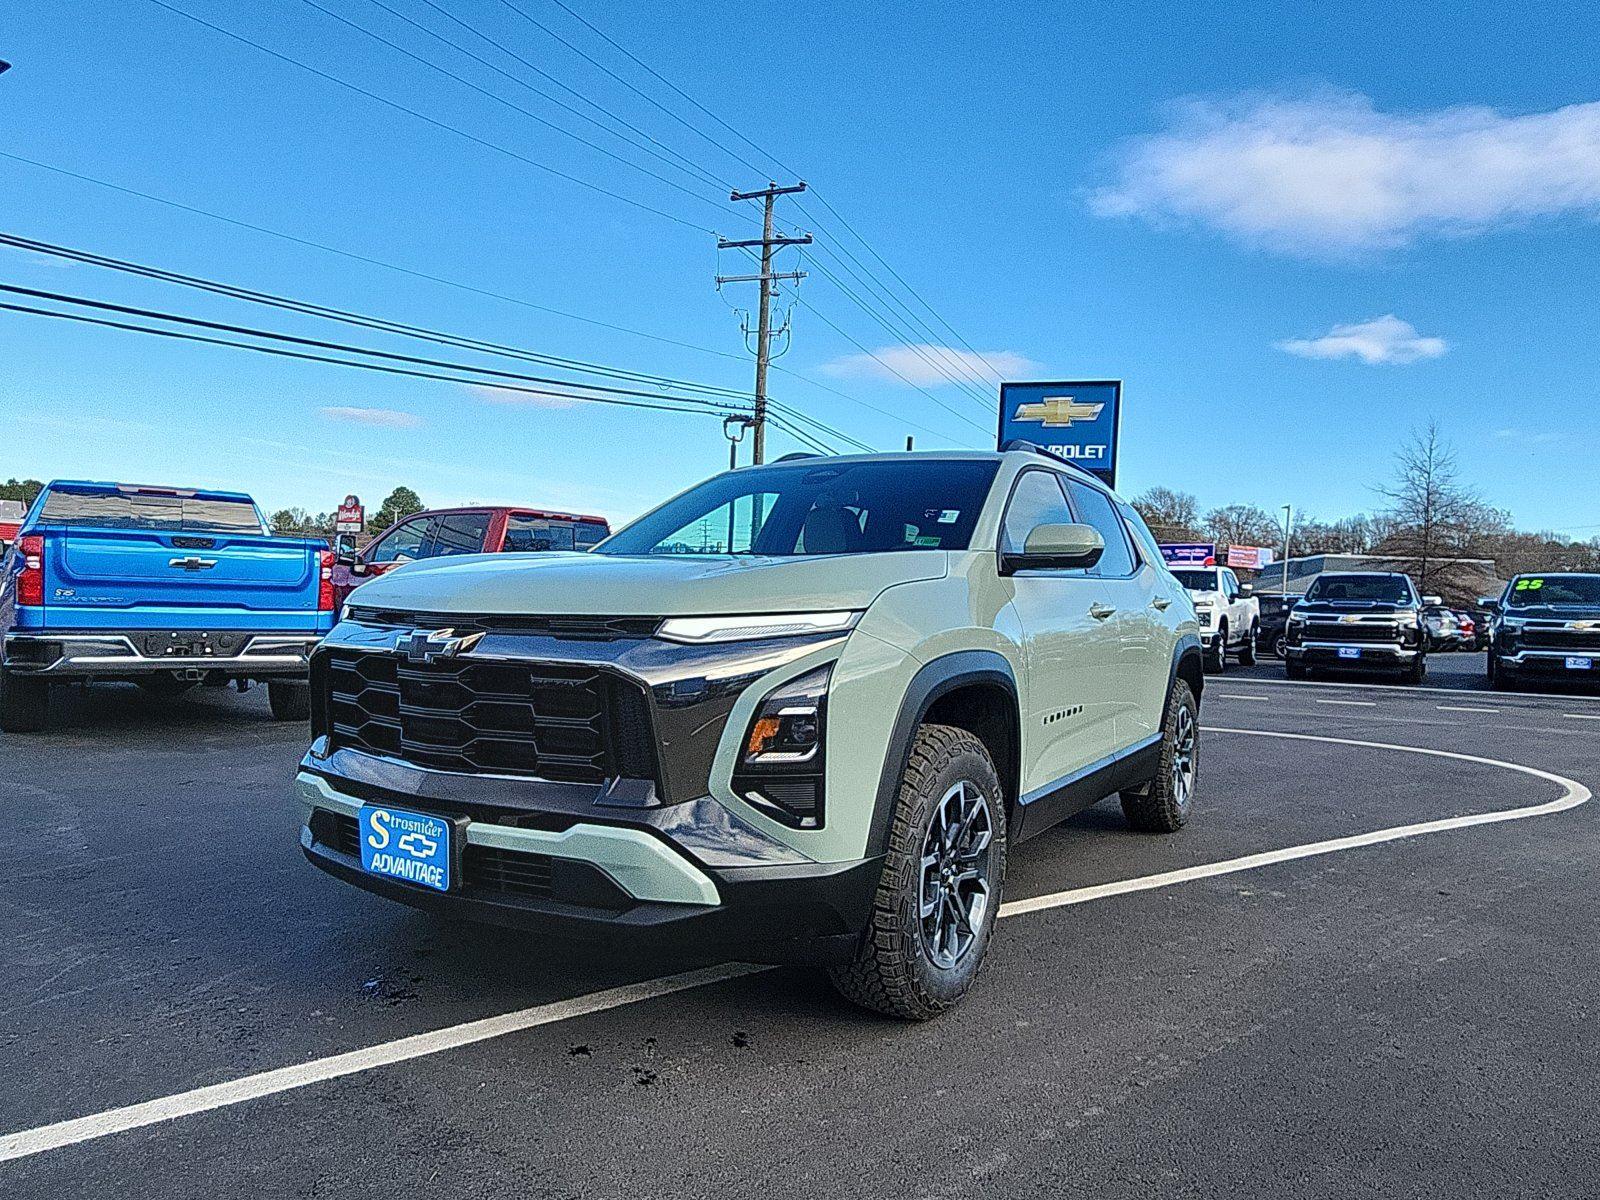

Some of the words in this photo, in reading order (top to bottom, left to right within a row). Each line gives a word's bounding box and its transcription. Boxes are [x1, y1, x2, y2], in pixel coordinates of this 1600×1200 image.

[1039, 444, 1107, 459] ROLET
[1515, 579, 1544, 591] 25
[370, 852, 444, 887] ADVANTAGE
